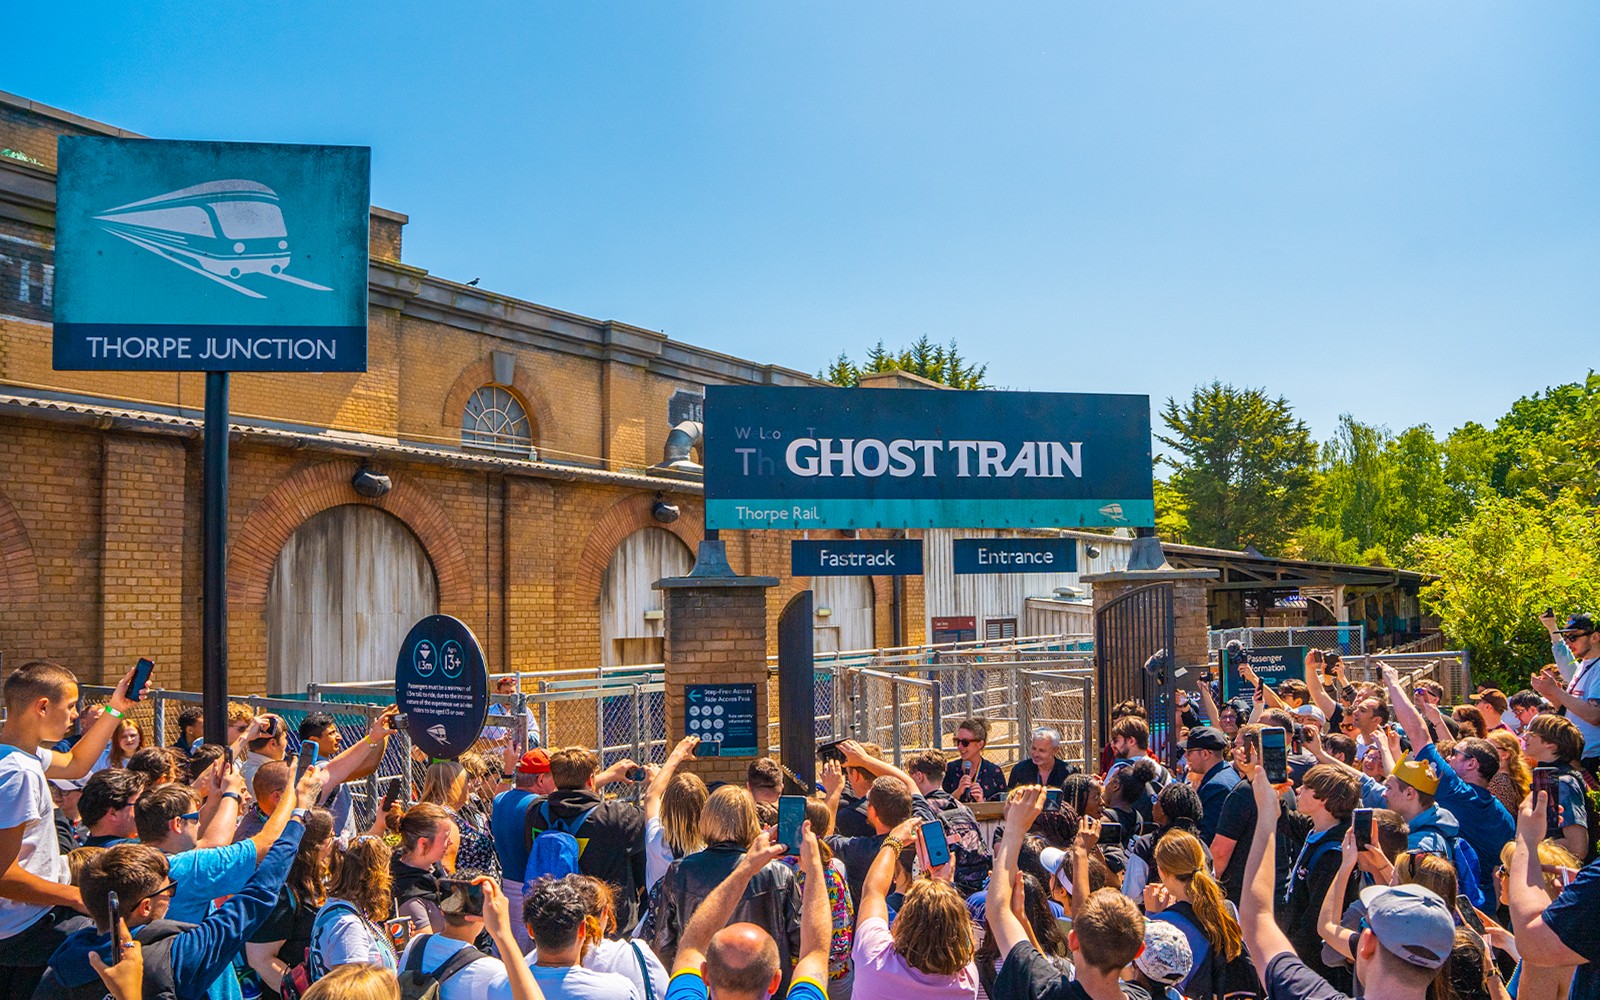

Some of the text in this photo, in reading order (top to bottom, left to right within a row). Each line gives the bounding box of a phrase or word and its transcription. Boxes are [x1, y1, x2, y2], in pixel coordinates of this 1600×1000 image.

[86, 336, 336, 360] THORPE JUNCTION
[785, 437, 1084, 478] GHOST TRAIN
[735, 506, 820, 523] Thorpe Rail
[819, 549, 896, 567] Fastrack
[977, 547, 1054, 565] Entrance
[444, 654, 461, 670] 13+
[1246, 654, 1282, 664] Passenger
